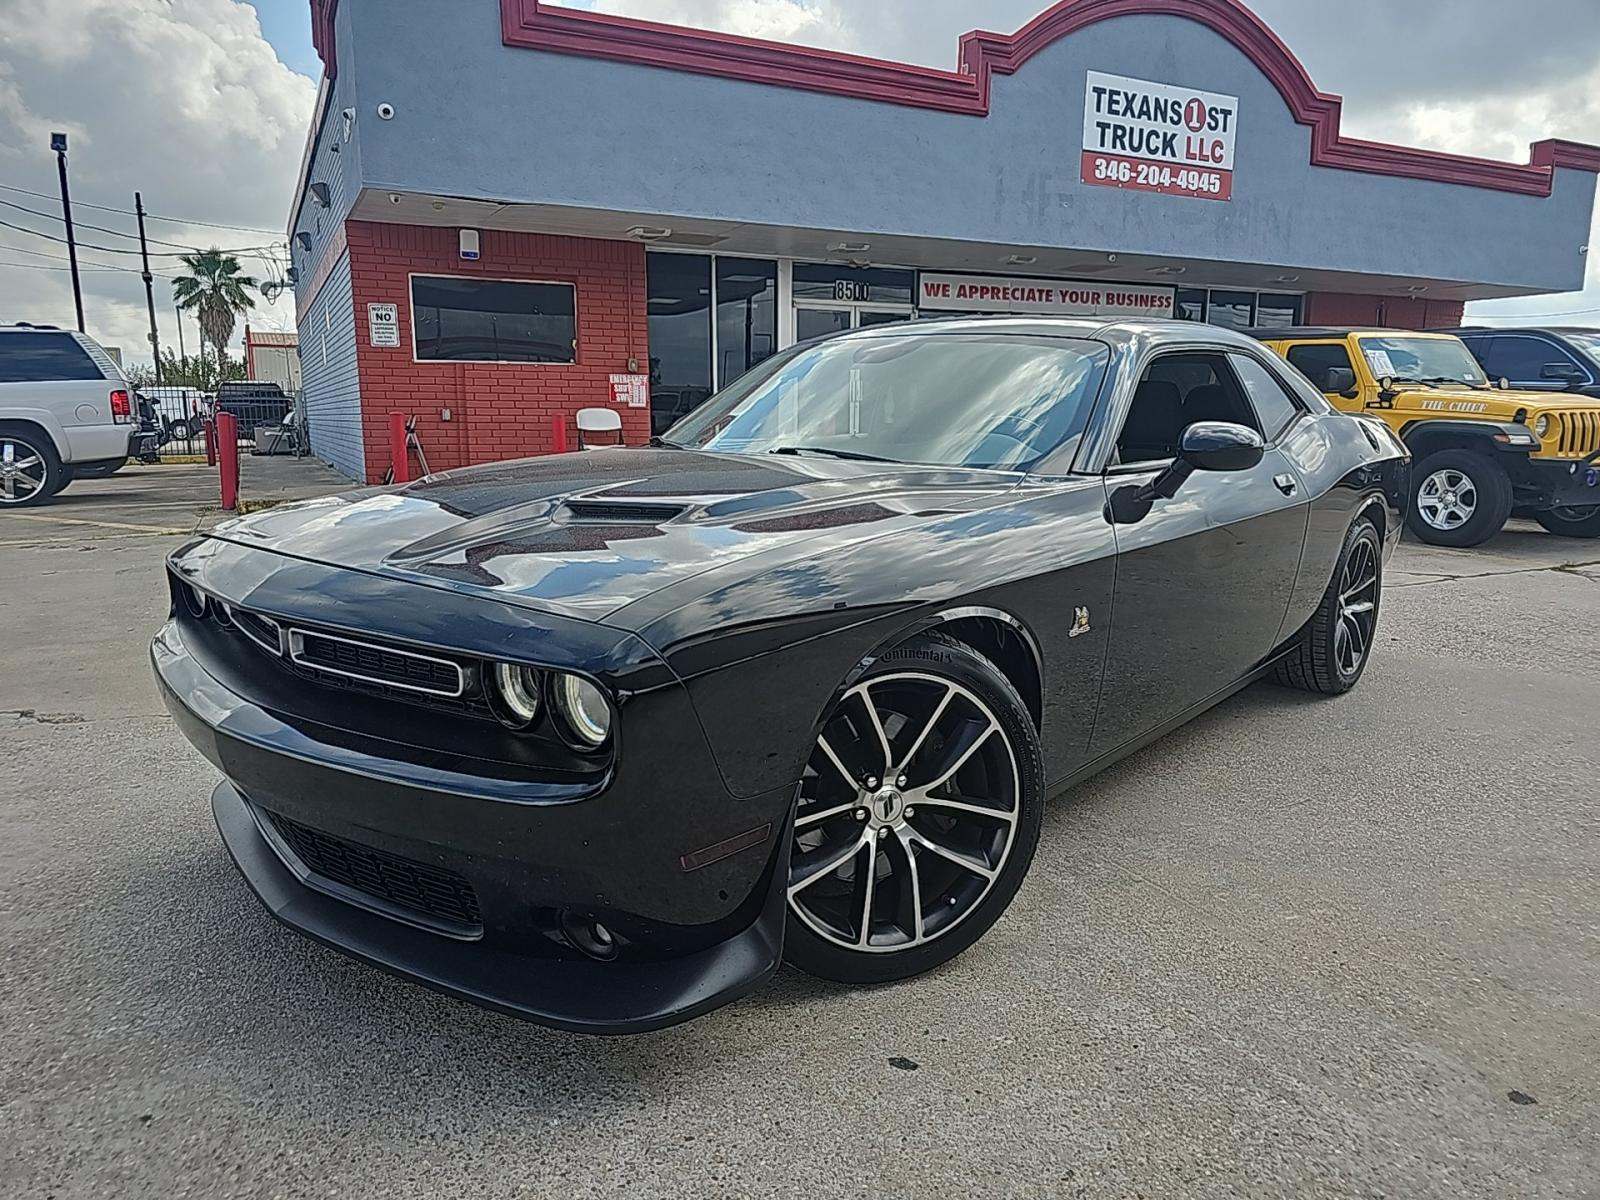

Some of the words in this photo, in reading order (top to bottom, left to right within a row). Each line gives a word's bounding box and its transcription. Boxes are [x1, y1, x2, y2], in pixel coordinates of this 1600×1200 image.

[1092, 86, 1182, 126] TEXANS
[1096, 121, 1178, 158] TRUCK
[1185, 136, 1224, 163] LLC
[1094, 158, 1220, 193] 346-204-4945
[837, 281, 869, 300] 8500
[924, 283, 950, 298] WE
[956, 284, 1053, 303] APPRECIATE
[1059, 289, 1101, 305] YOUR
[1106, 293, 1172, 309] BUSINESS
[376, 313, 391, 321] NO
